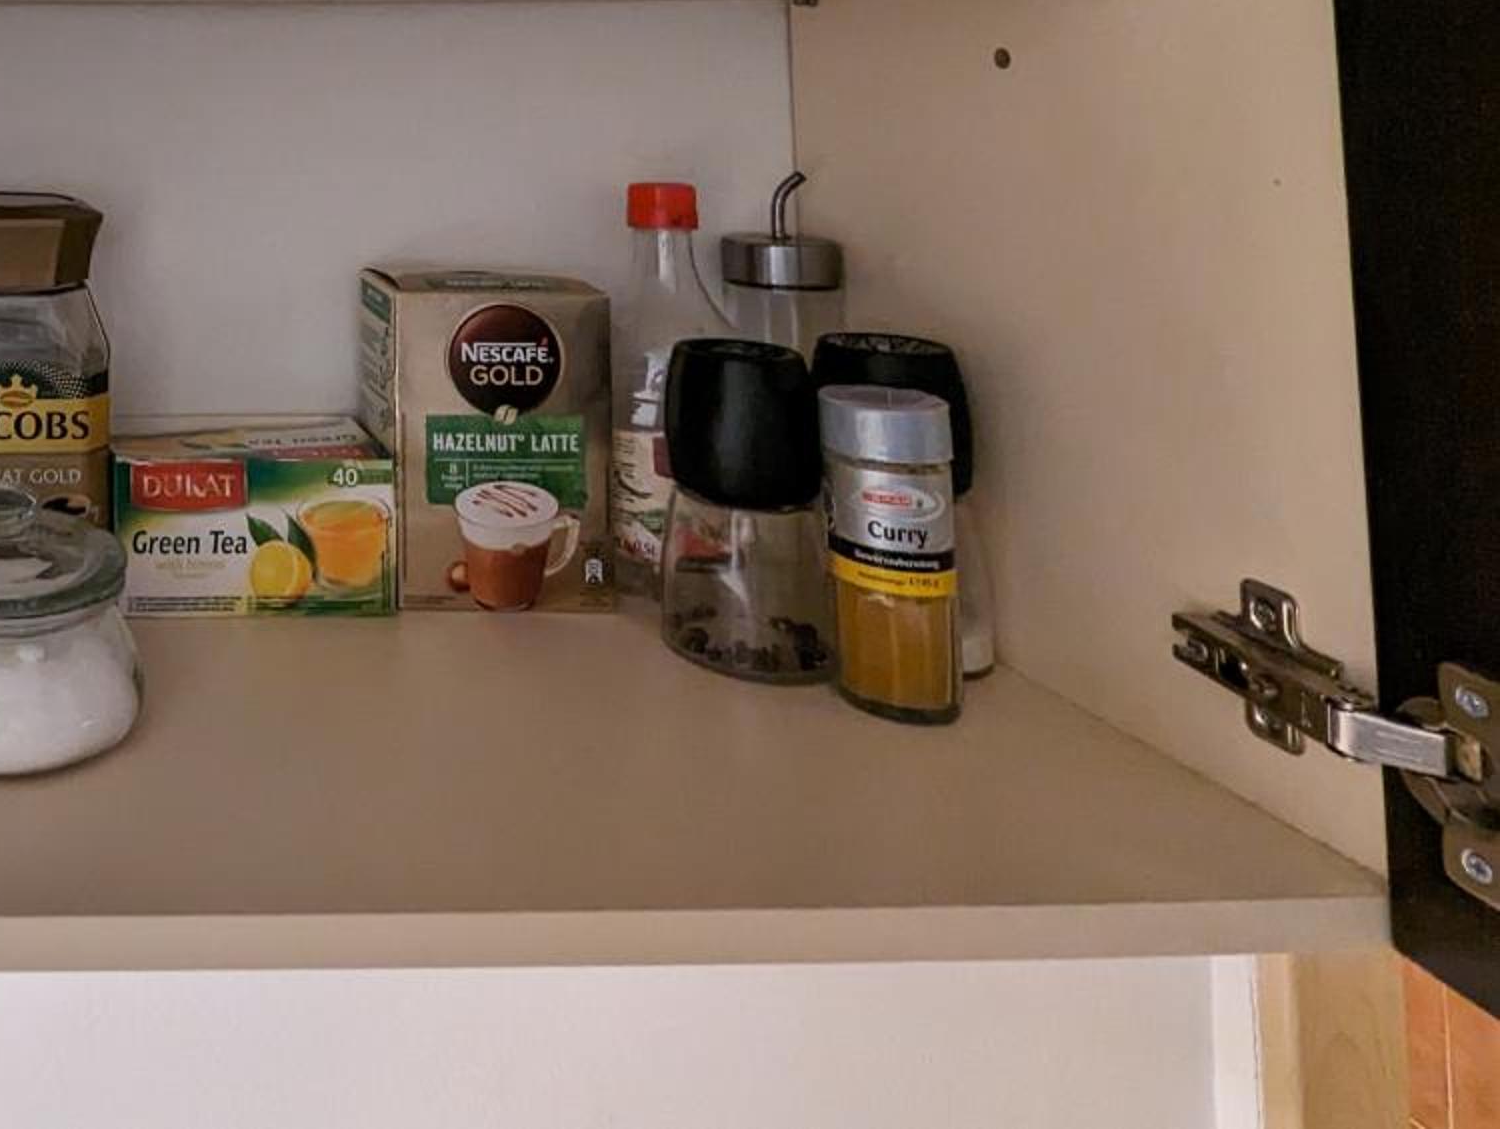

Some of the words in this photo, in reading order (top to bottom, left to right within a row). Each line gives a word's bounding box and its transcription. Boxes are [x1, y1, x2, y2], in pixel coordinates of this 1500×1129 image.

[469, 364, 544, 386] GOLD
[530, 434, 580, 452] LATTE
[28, 468, 83, 485] GOLD
[142, 475, 236, 499] DUKAT
[332, 468, 359, 487] 40
[132, 530, 201, 555] Green
[209, 530, 249, 555] Tea
[867, 520, 928, 550] Curry
